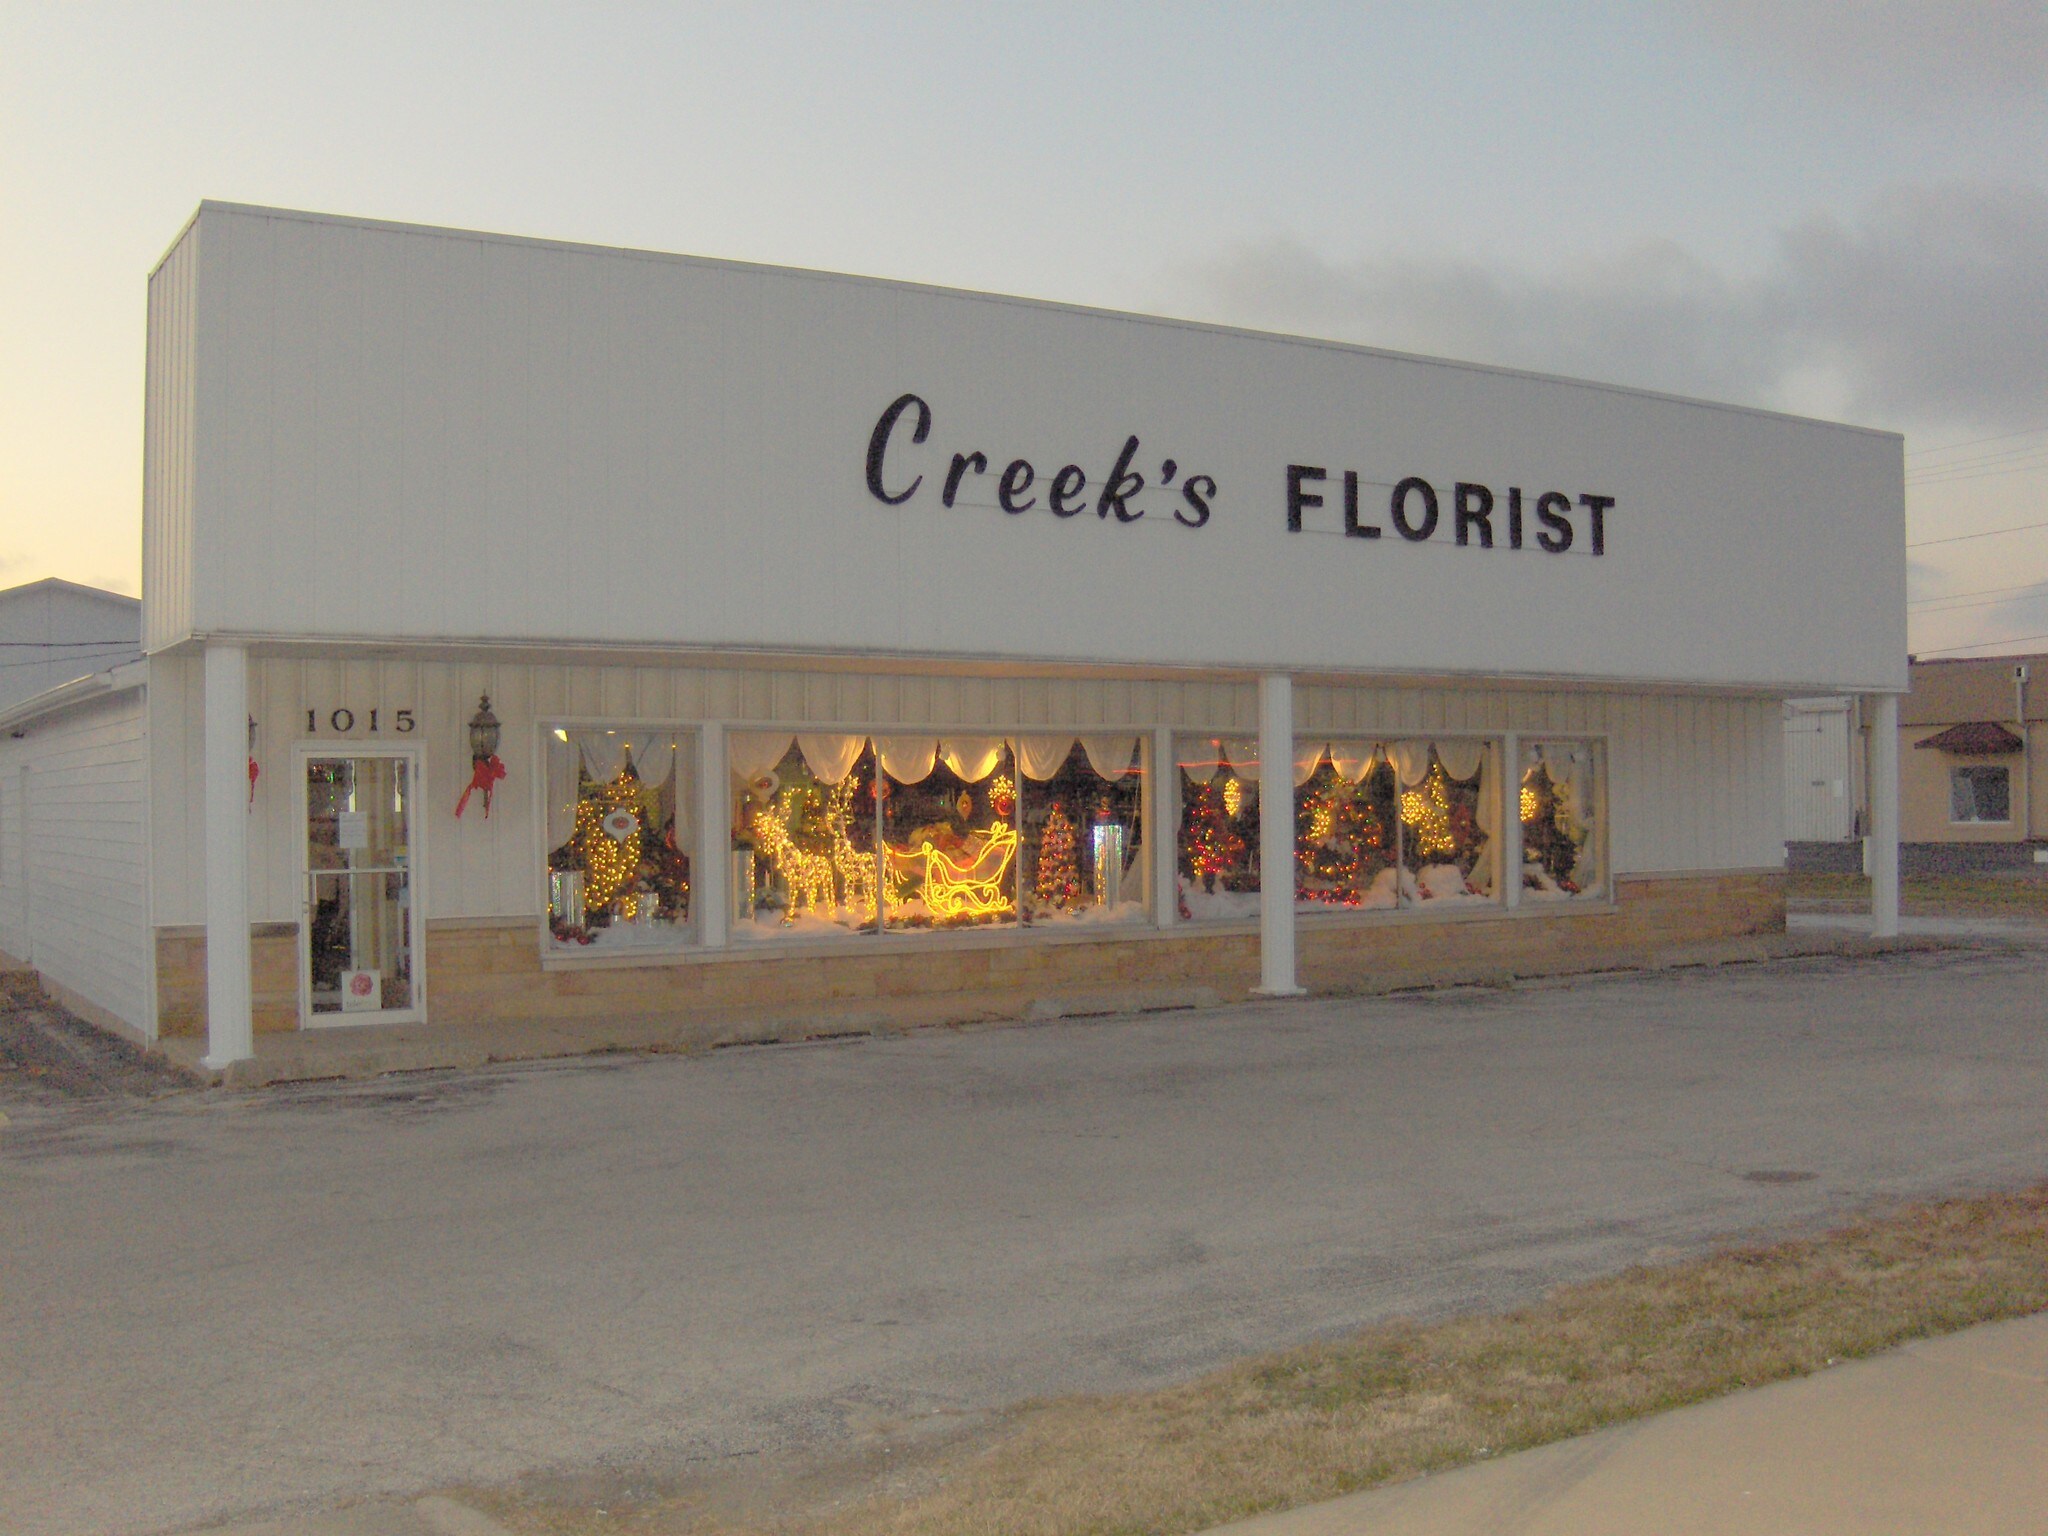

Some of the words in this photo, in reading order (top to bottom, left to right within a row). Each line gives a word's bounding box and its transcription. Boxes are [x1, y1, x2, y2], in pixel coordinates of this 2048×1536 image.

[866, 394, 1217, 528] Creek's
[1286, 464, 1615, 556] FLORIST
[307, 708, 416, 733] 1015
